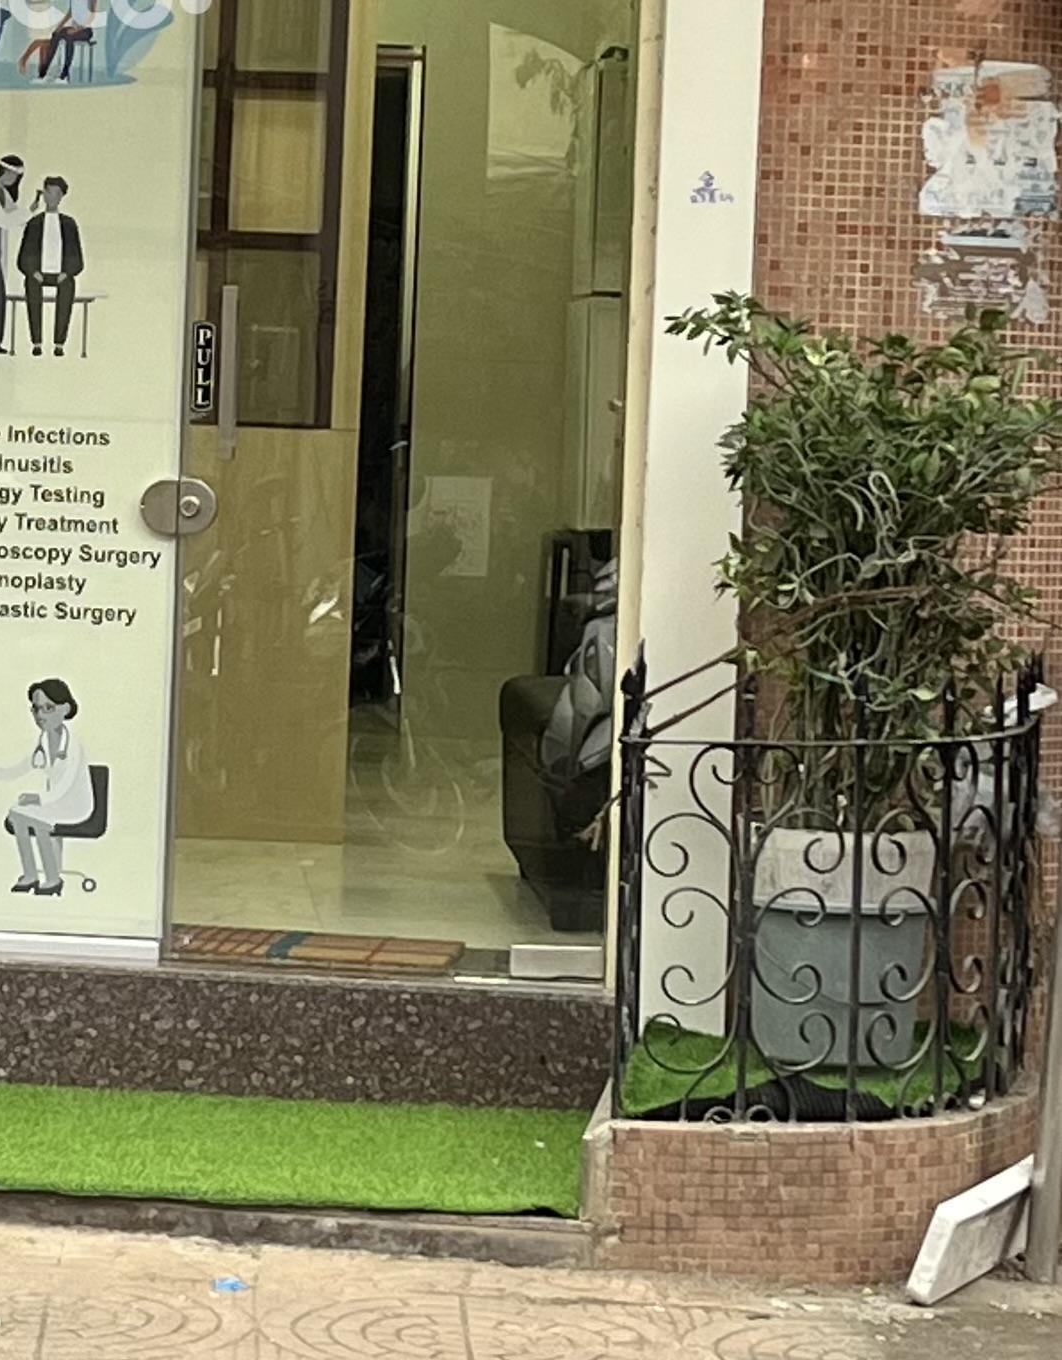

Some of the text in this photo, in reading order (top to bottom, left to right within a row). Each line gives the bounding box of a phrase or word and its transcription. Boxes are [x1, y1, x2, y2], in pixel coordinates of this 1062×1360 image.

[196, 329, 212, 405] PULL
[7, 426, 110, 446] Infections
[30, 485, 105, 508] Testing
[15, 513, 119, 534] Treatment
[79, 544, 161, 569] Surgery
[54, 602, 136, 626] Surgery
